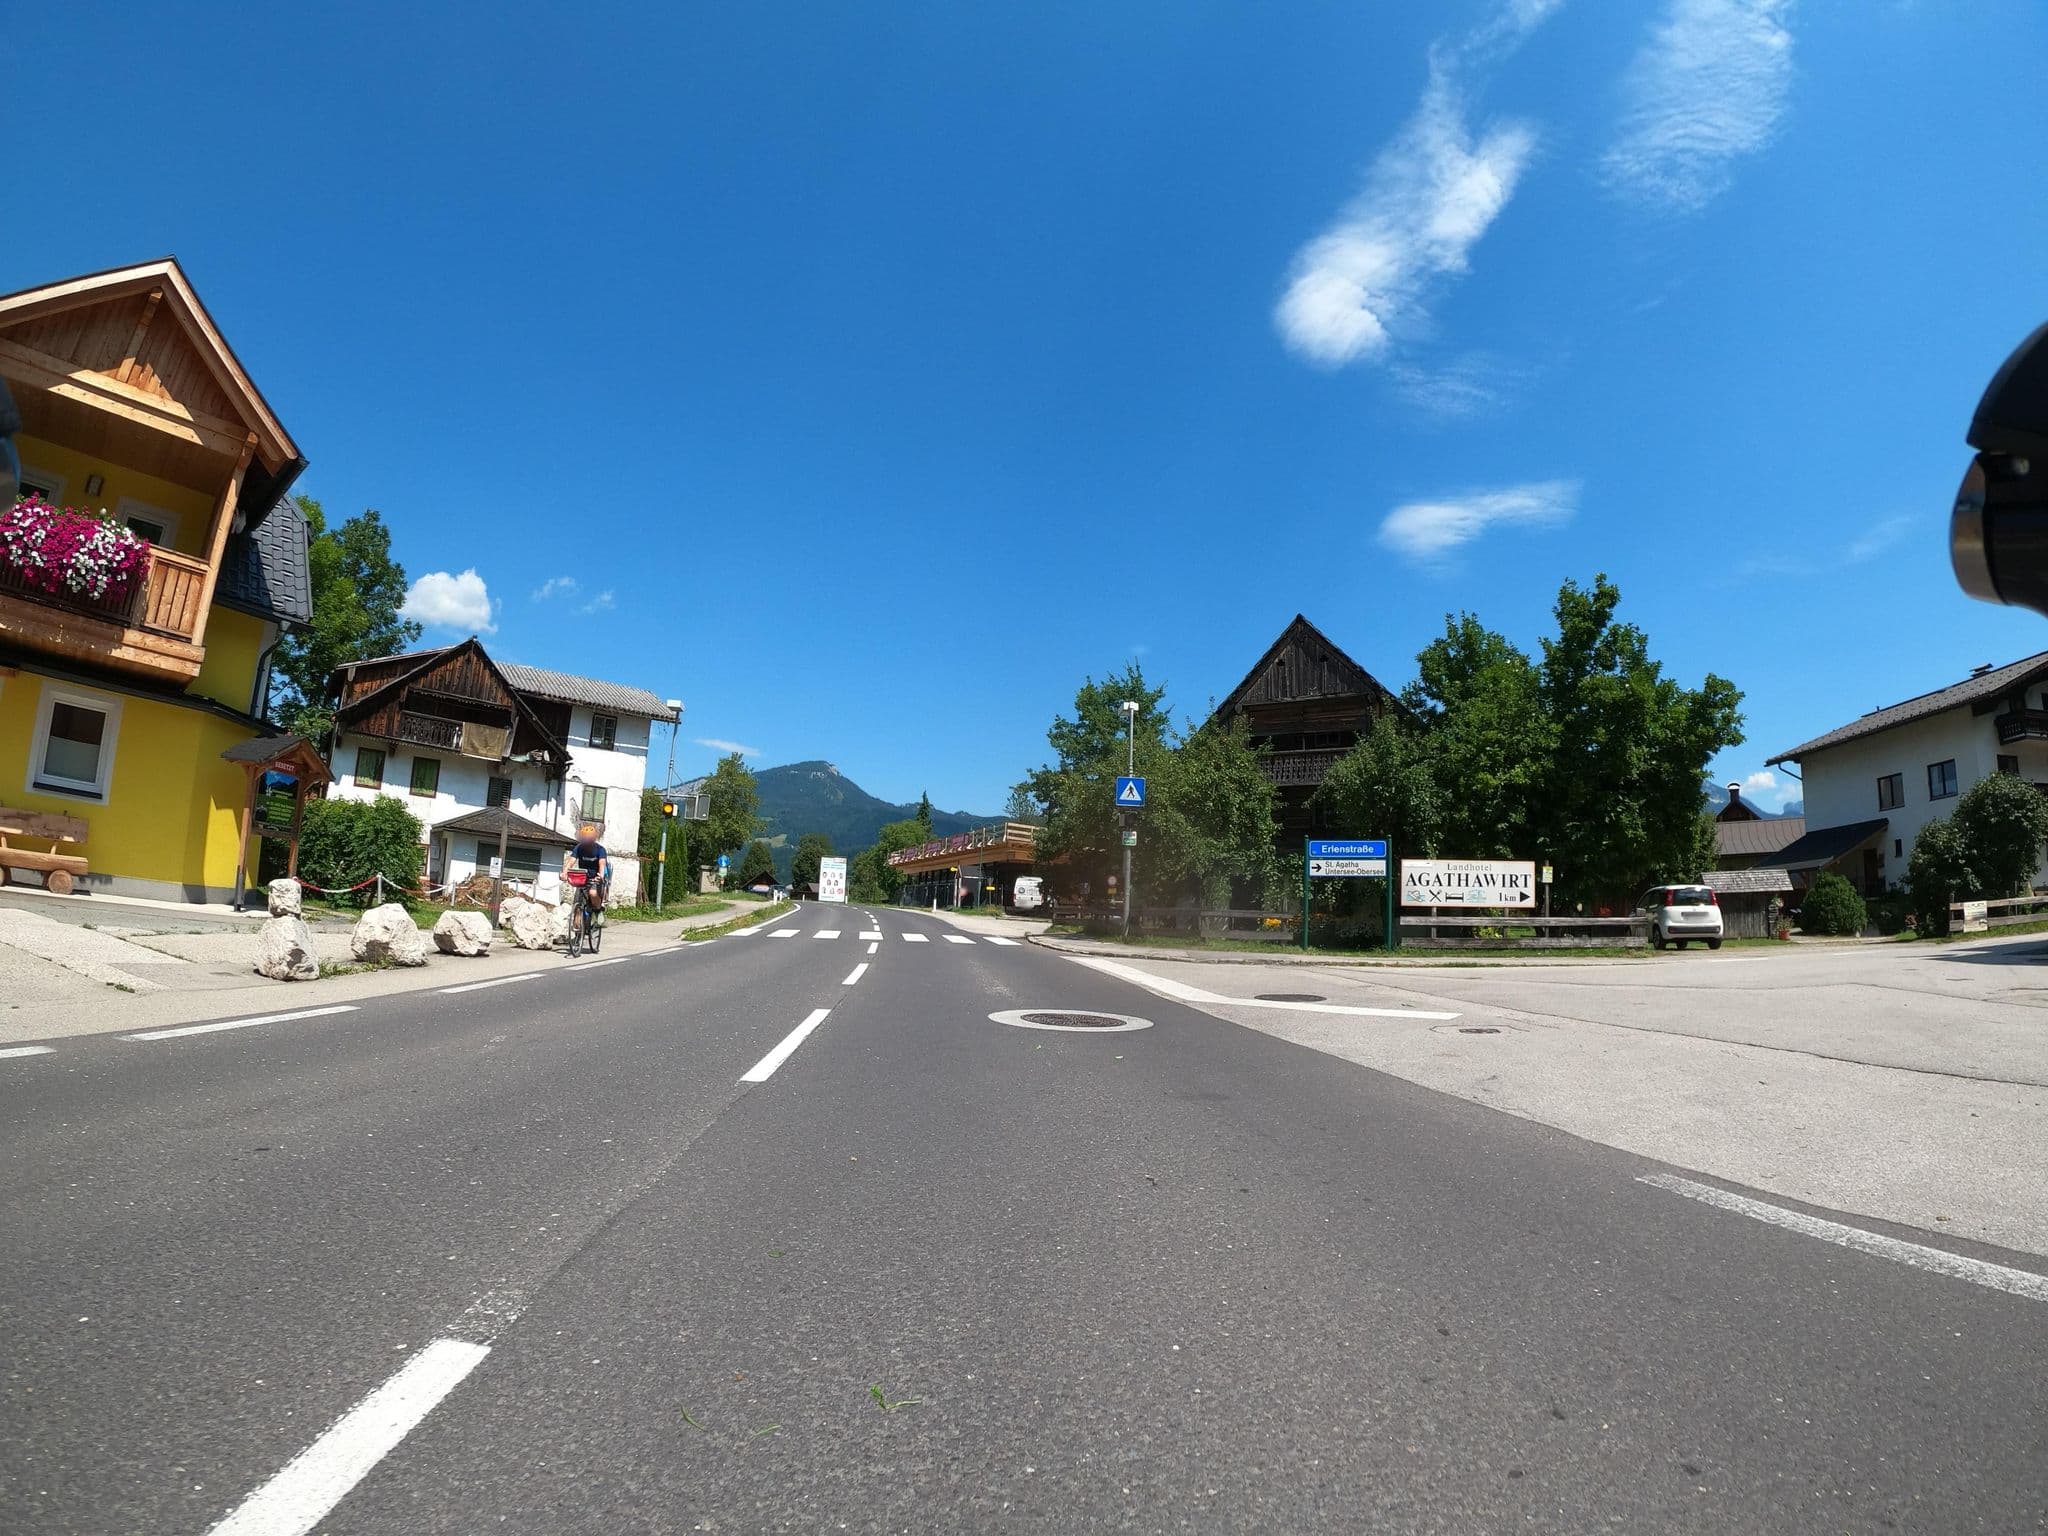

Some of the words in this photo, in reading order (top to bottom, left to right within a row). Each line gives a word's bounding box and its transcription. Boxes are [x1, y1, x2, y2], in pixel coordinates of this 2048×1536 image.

[1321, 845, 1374, 853] Erlenstraße
[1335, 861, 1359, 869] Agatha
[1447, 863, 1492, 872] Landhotel
[1405, 872, 1531, 888] AGATHAWIRT
[1499, 892, 1503, 902] 1
[1504, 893, 1517, 902] km
